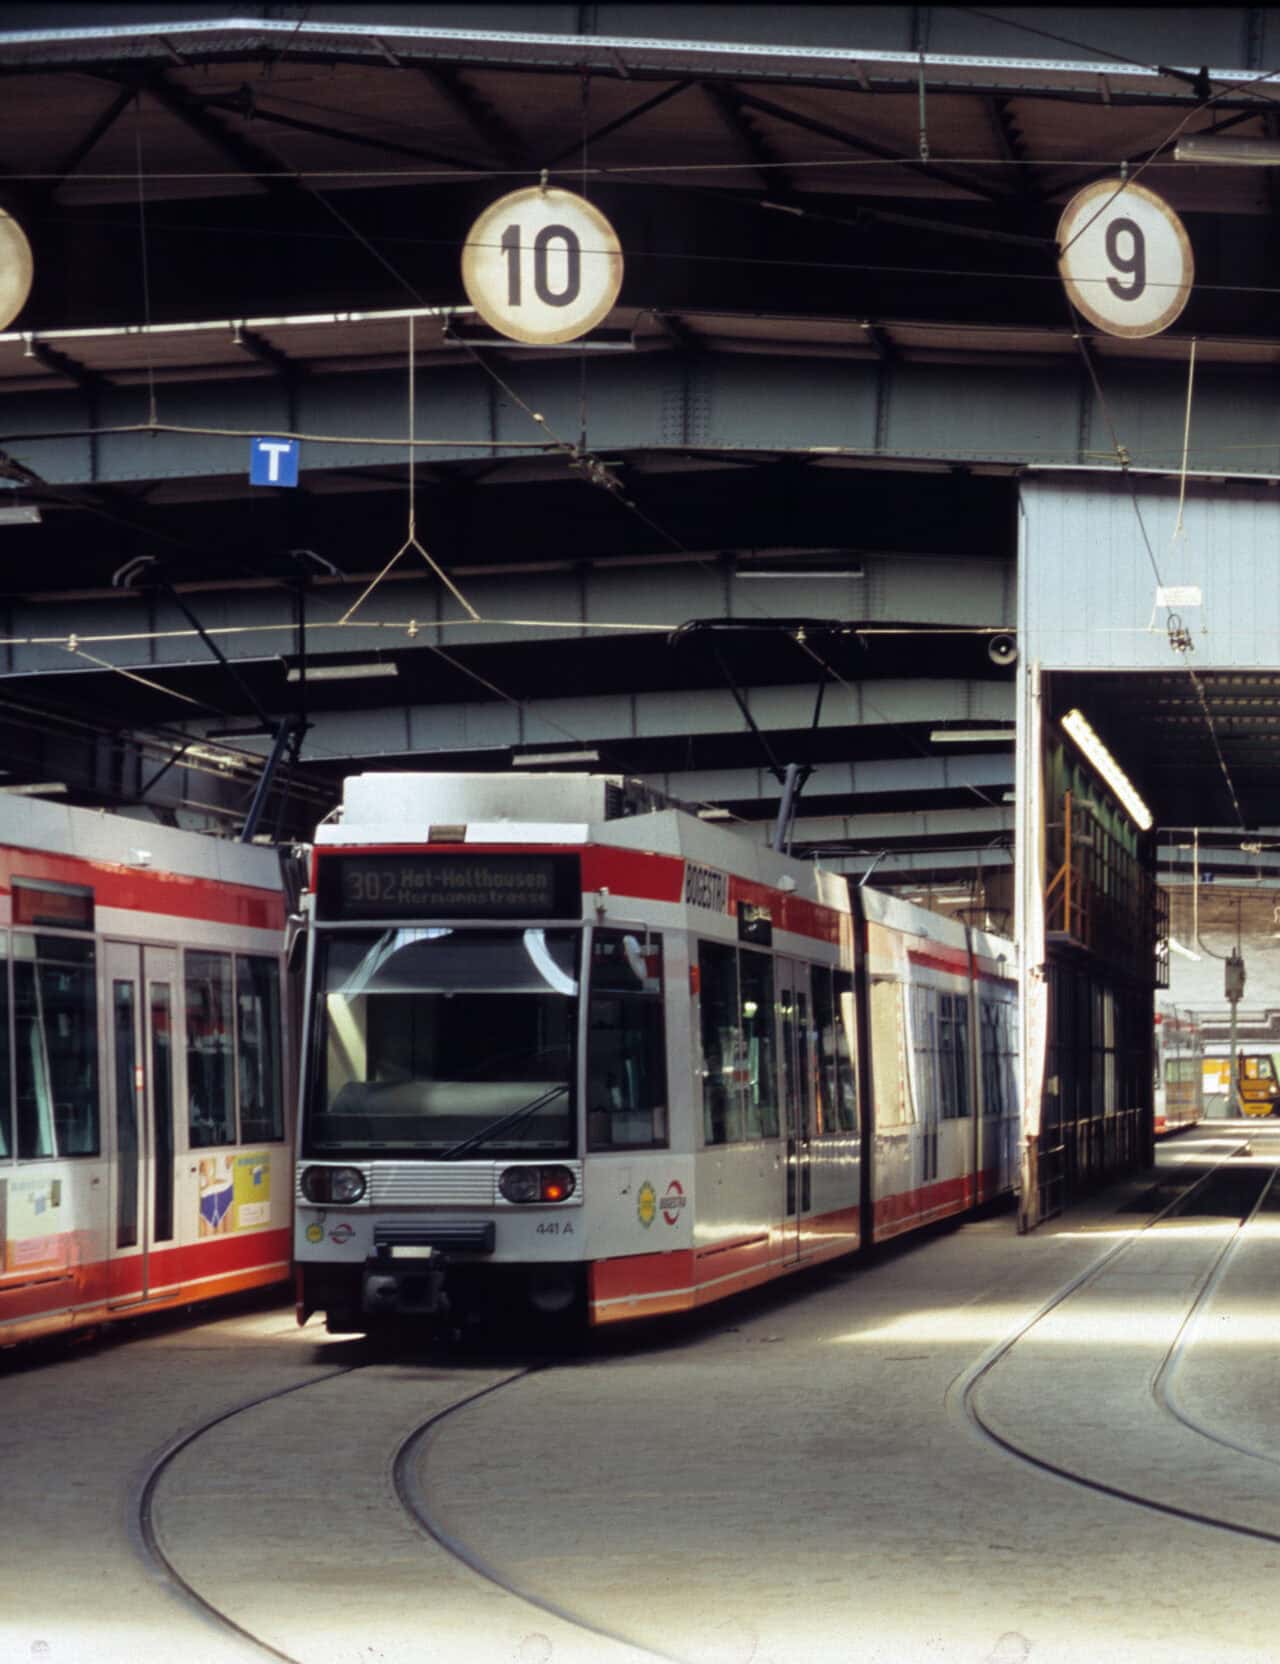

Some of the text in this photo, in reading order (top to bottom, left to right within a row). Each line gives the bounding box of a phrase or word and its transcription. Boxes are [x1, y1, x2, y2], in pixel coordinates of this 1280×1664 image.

[501, 223, 581, 308] 10
[1105, 217, 1147, 302] 9
[258, 442, 291, 482] T
[346, 871, 396, 901] 302
[535, 1220, 576, 1235] 441 A
